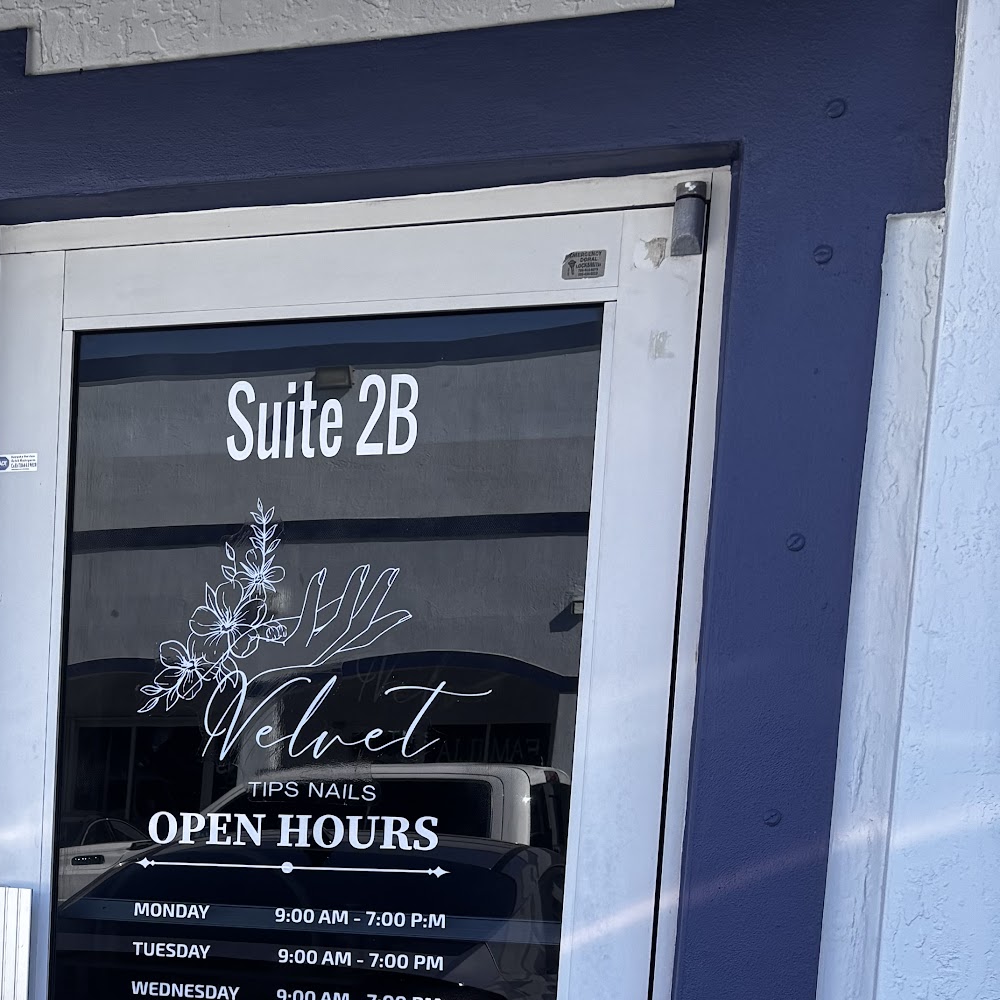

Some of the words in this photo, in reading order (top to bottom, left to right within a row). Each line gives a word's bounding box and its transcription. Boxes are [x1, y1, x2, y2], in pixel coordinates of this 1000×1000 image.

[226, 380, 343, 461] Suite
[355, 373, 419, 456] 2B
[202, 671, 492, 762] Velvet
[247, 781, 299, 798] TIPS
[308, 782, 376, 802] NAILS
[148, 811, 267, 847] OPEN
[276, 814, 439, 851] HOURS
[133, 902, 210, 919] MONDAY
[274, 907, 315, 924] 9:00
[317, 909, 349, 925] AM
[365, 910, 406, 928] 7:00
[410, 912, 446, 929] P:M
[132, 941, 211, 959] TUESDAY
[278, 948, 318, 965] 9:00
[321, 950, 352, 967] AM
[368, 952, 409, 970] 7:00
[413, 954, 444, 971] PM
[131, 980, 240, 1000] WEDNESDAY
